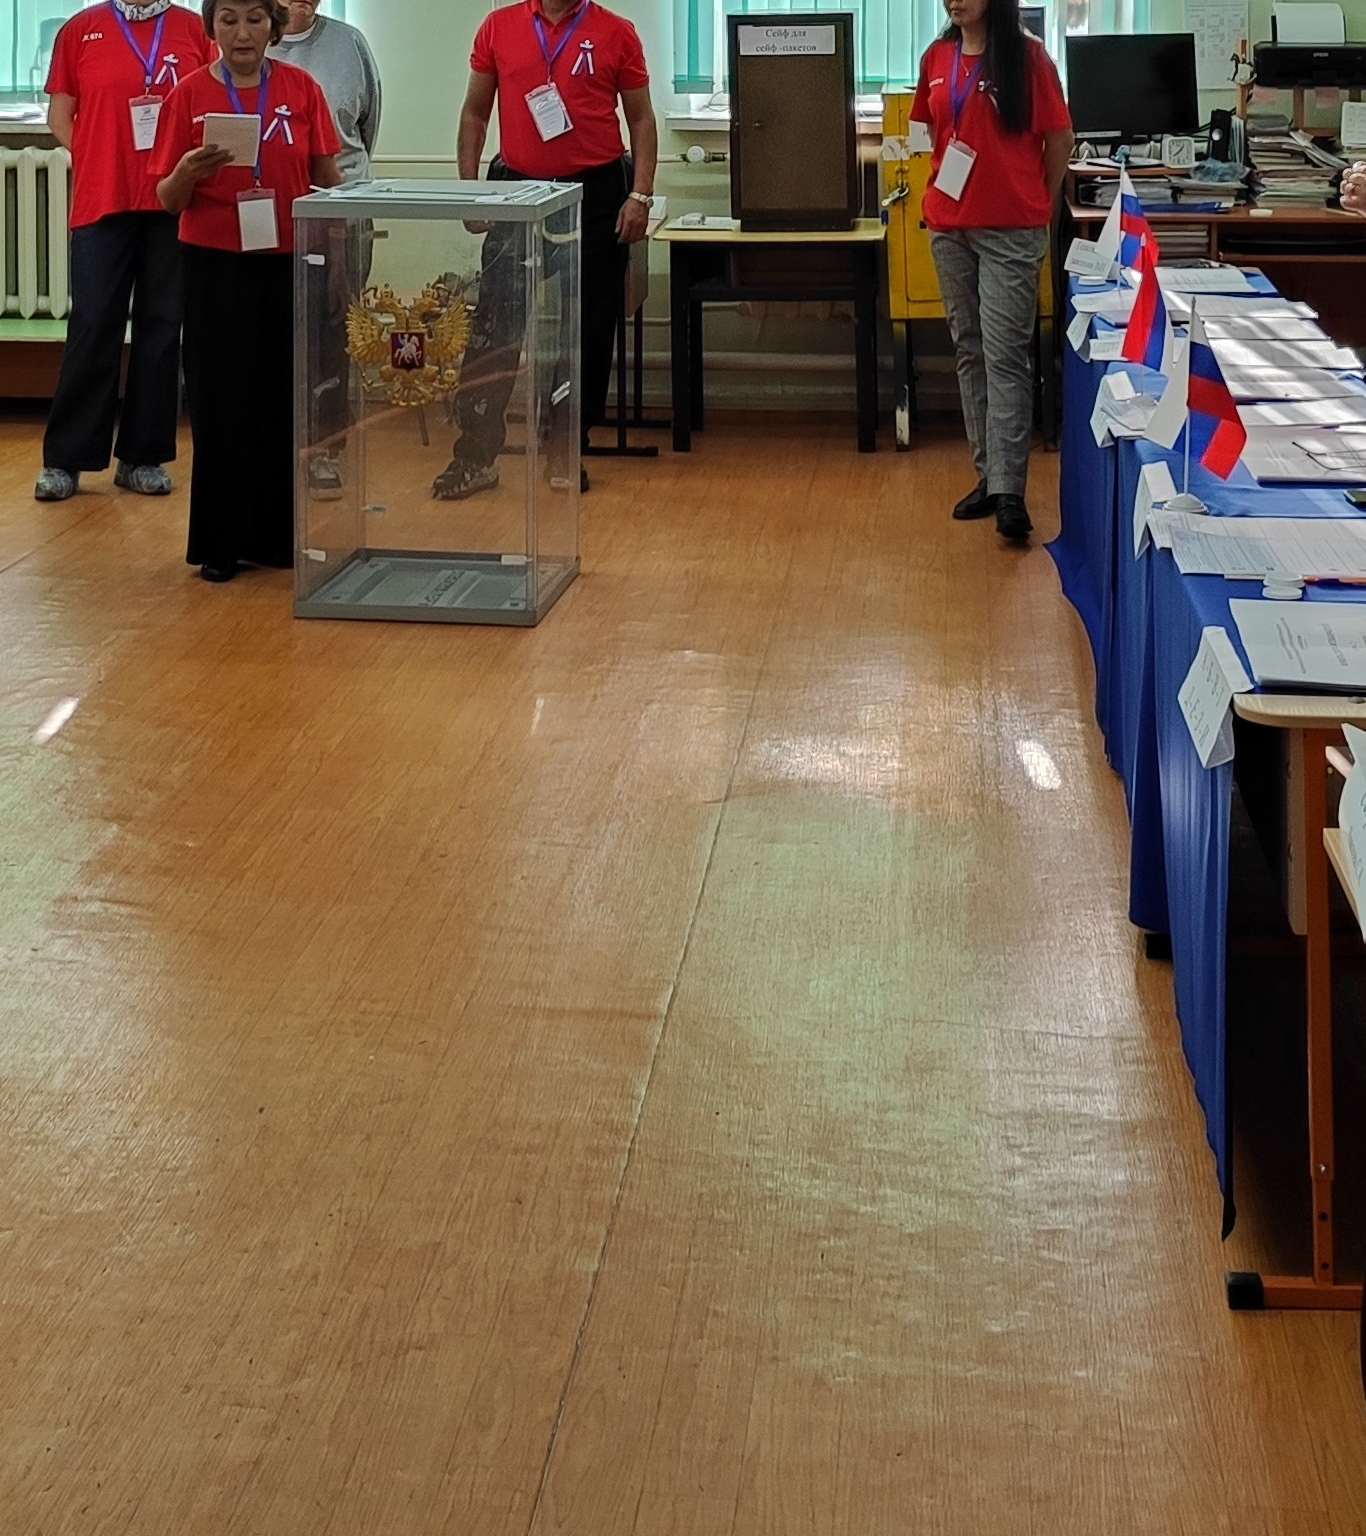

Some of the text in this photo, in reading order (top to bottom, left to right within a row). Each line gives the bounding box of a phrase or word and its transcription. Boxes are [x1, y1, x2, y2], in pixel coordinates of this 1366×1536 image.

[765, 29, 807, 39] Сейф для
[755, 43, 778, 53] сейф
